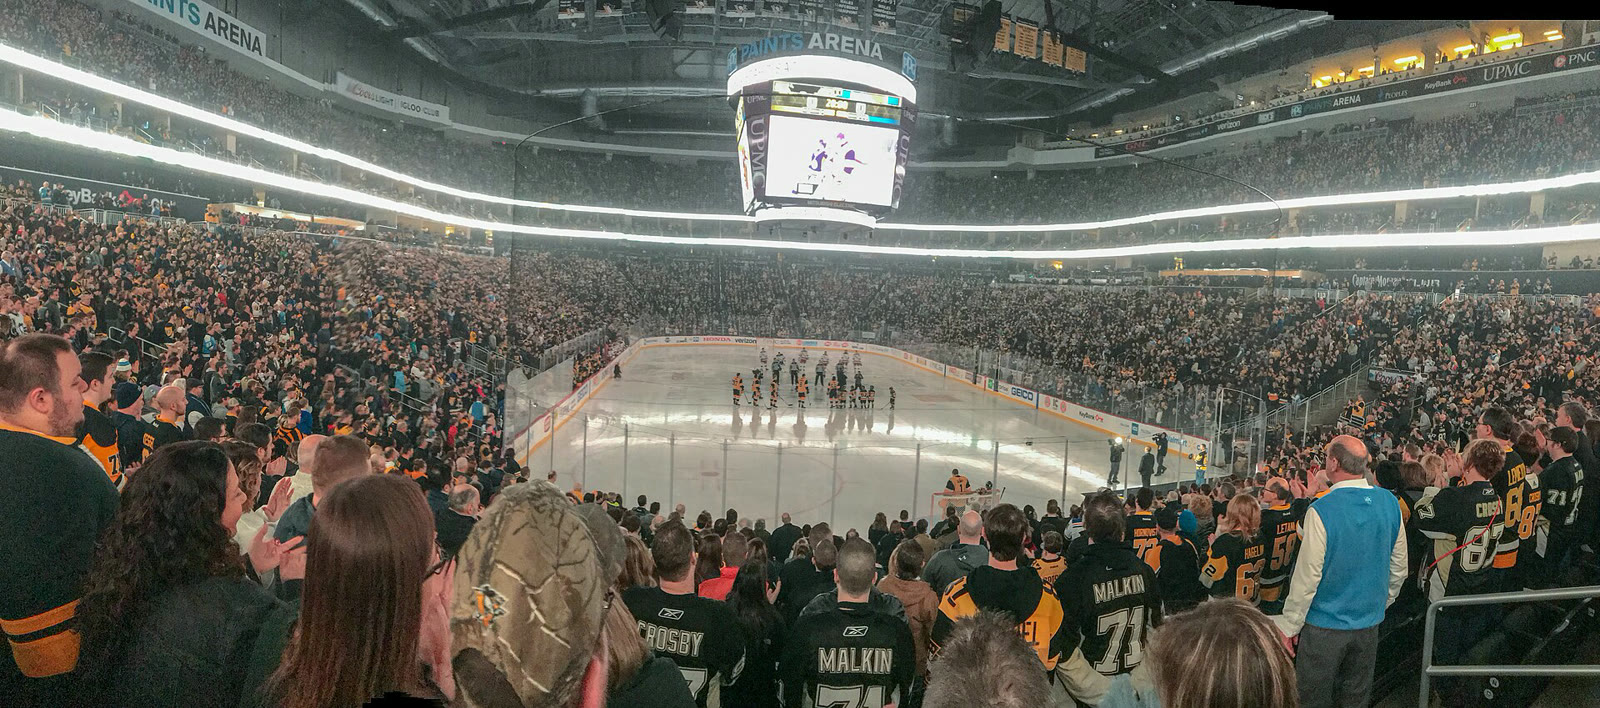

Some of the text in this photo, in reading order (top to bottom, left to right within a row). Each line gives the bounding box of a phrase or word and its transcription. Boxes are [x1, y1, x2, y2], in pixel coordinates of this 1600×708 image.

[204, 11, 263, 56] ARENA
[741, 33, 883, 62] PAINTS ARENA
[1568, 51, 1596, 65] PNC
[1483, 61, 1532, 82] UPMC
[1424, 79, 1452, 91] KeyBank
[747, 95, 767, 104] UPMC
[1333, 94, 1361, 107] ARENA
[1217, 120, 1241, 130] verizon
[751, 118, 767, 189] UPMC
[1011, 386, 1034, 402] GEICO
[1079, 410, 1095, 421] KeyBank
[1547, 489, 1567, 506] 71
[1460, 522, 1505, 573] 87
[1093, 574, 1145, 604] MALKIN
[1094, 605, 1145, 676] 71
[818, 647, 893, 675] MALKIN
